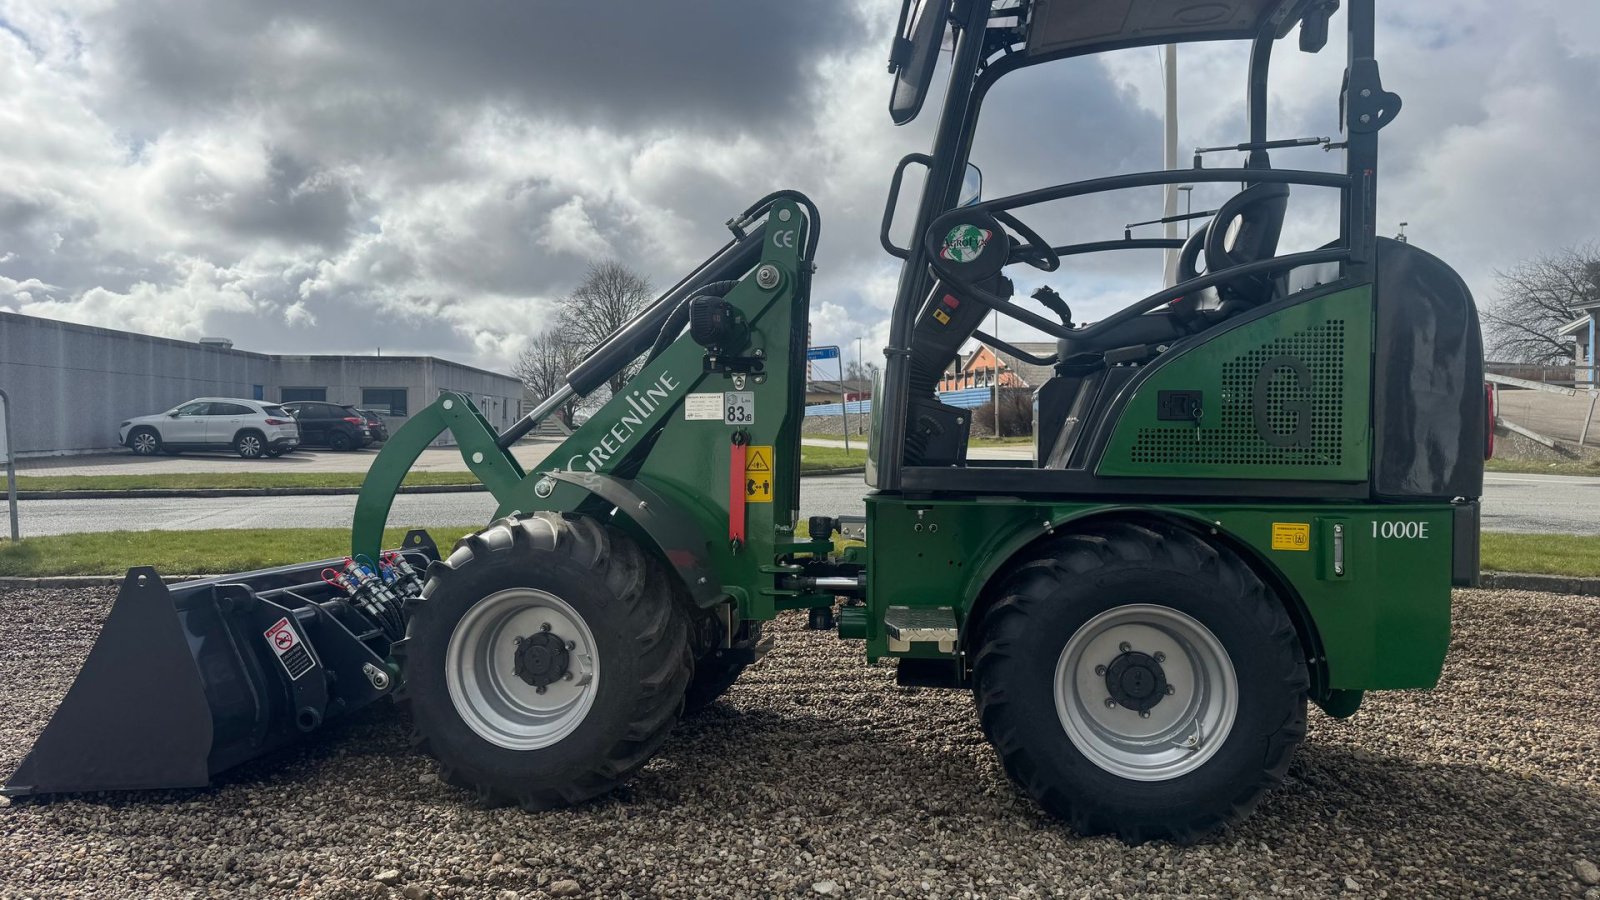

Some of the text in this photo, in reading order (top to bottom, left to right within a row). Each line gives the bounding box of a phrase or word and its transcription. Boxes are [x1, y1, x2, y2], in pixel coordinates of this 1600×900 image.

[772, 230, 794, 248] CE
[1252, 354, 1312, 448] G
[1371, 520, 1429, 539] 1000E
